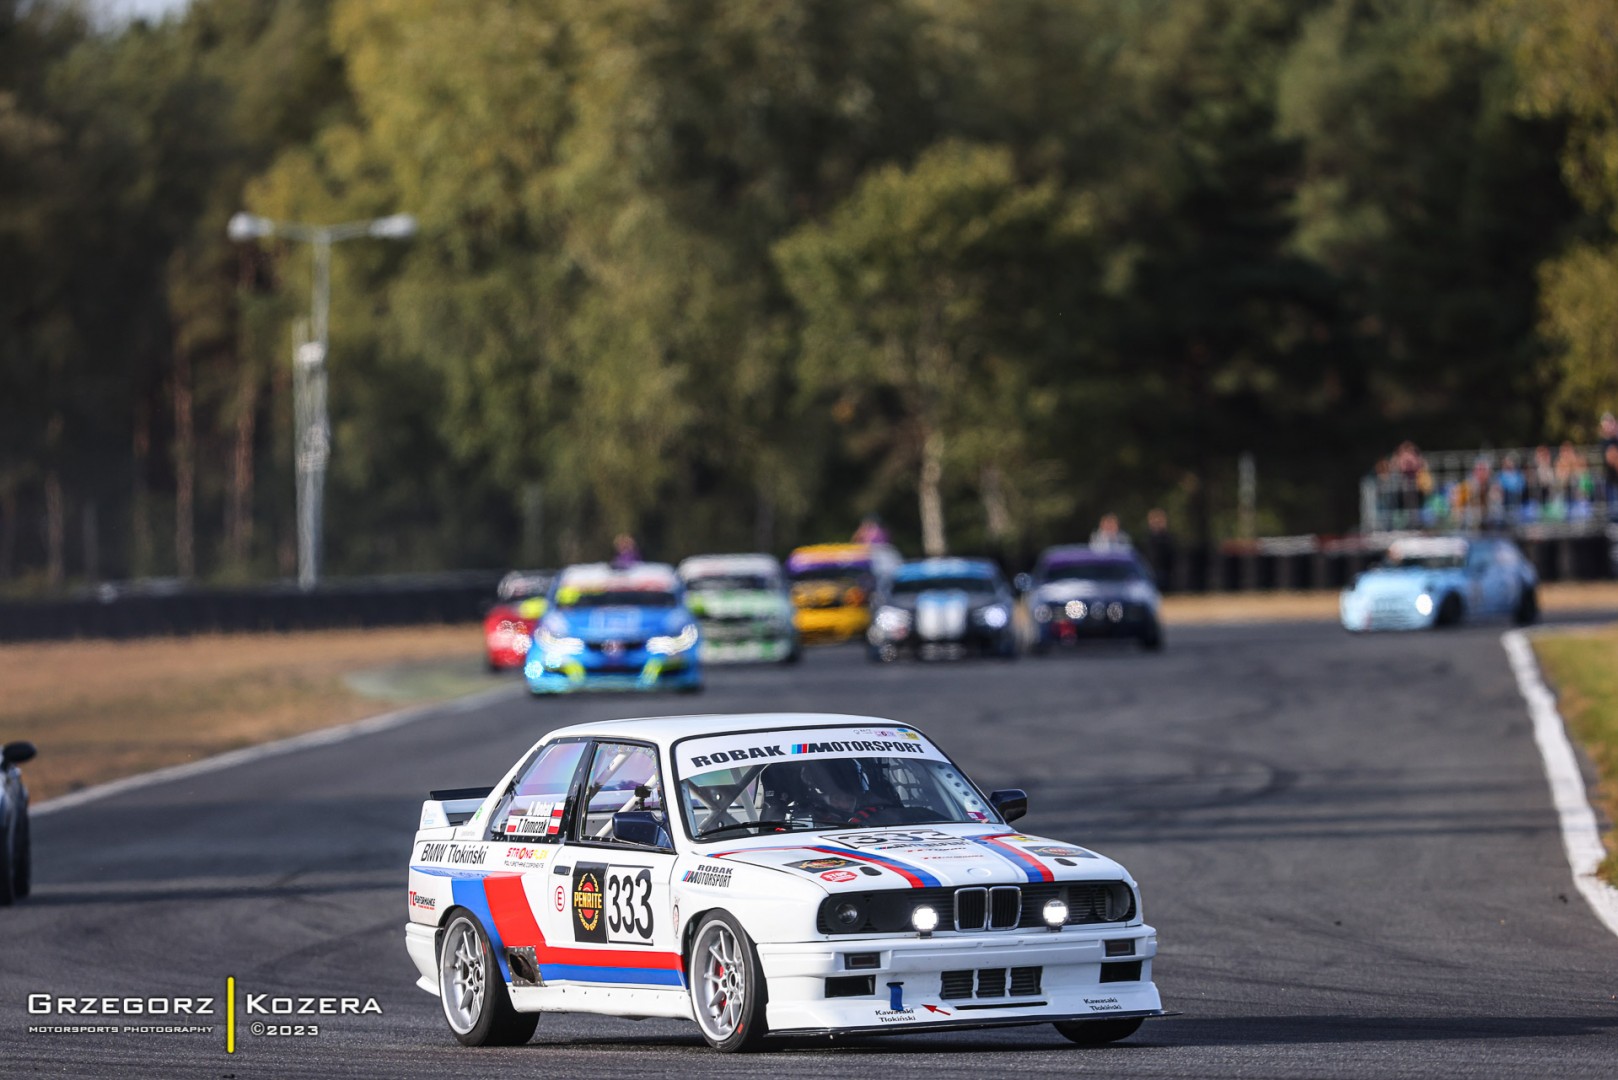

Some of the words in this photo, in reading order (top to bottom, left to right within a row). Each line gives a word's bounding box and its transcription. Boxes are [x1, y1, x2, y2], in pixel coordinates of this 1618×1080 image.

[690, 745, 786, 768] ROBAK
[807, 740, 924, 754] MOTORSPORT
[521, 818, 548, 834] Tomczak
[420, 843, 448, 862] BMW
[447, 844, 489, 865] Tłokiński
[697, 864, 734, 875] ROBAK
[687, 870, 732, 888] MOTORSPORT
[573, 891, 603, 909] PENRITE
[608, 868, 654, 940] 333
